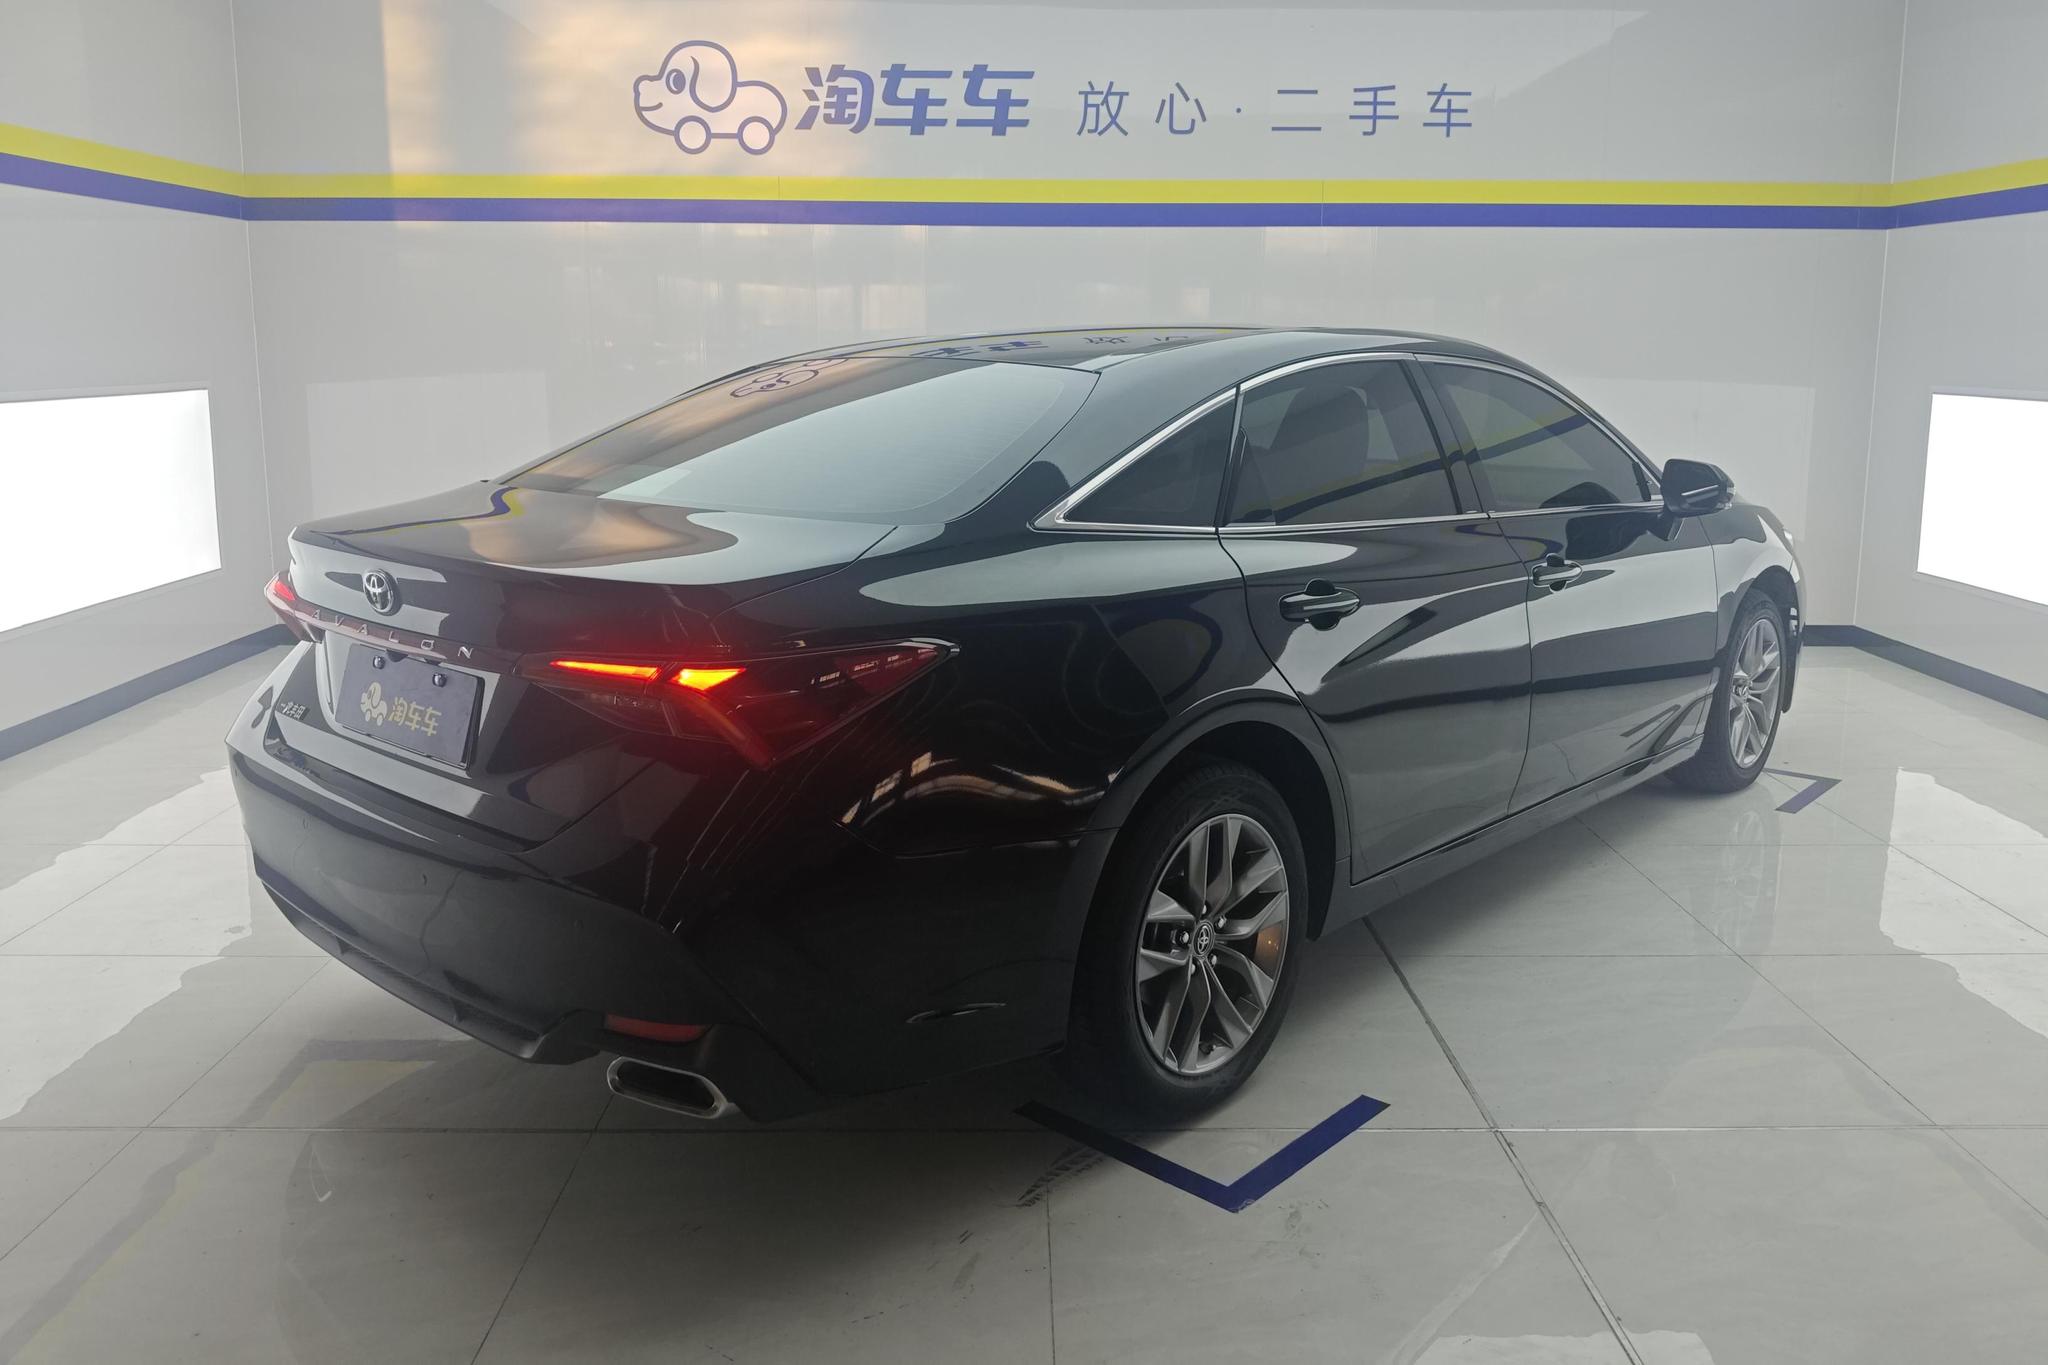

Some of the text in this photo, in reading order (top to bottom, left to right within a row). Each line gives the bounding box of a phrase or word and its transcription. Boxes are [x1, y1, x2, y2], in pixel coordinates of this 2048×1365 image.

[795, 63, 1035, 137] 淘车车
[312, 609, 475, 660] AVALON
[388, 696, 442, 737] 淘车车
